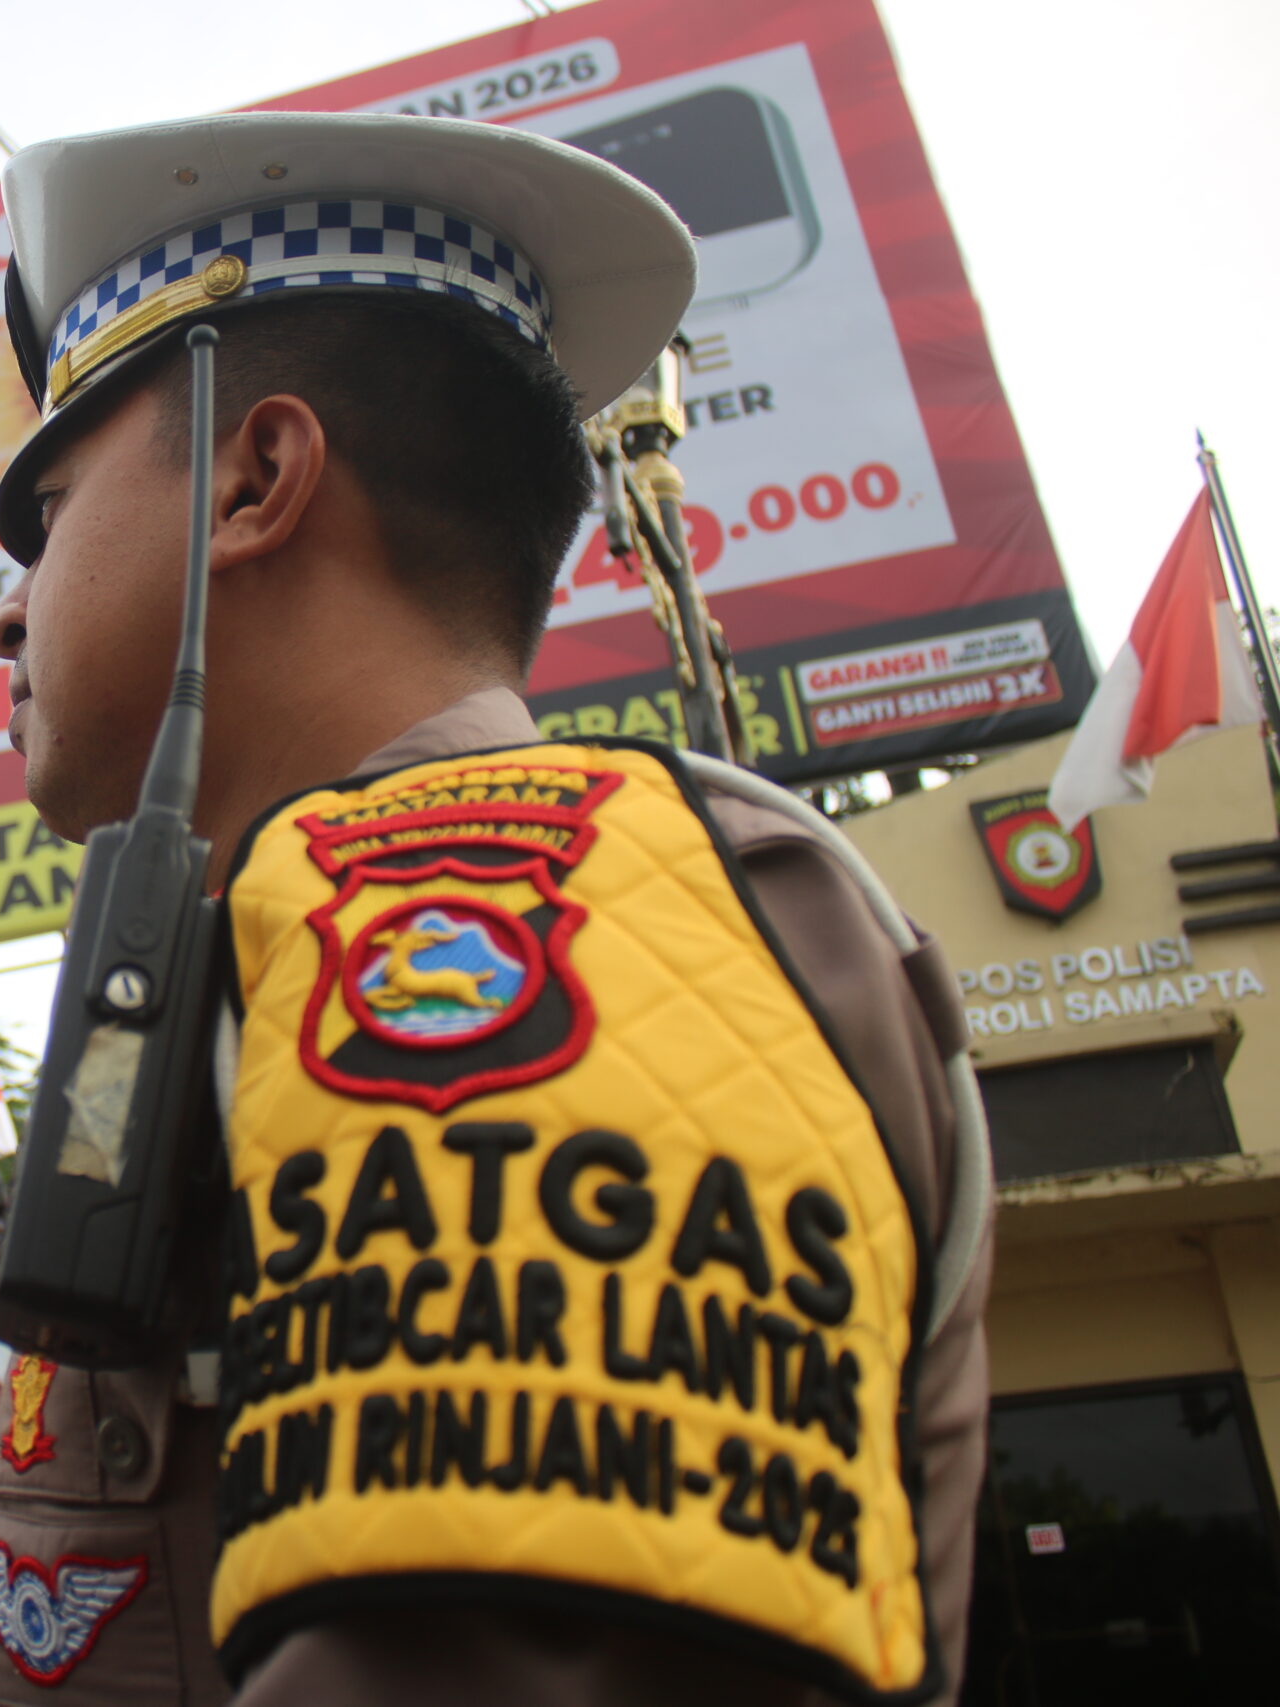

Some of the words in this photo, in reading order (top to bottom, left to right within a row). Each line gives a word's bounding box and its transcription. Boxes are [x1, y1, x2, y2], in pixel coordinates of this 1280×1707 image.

[475, 52, 599, 111] 2026
[683, 383, 775, 428] TER
[808, 652, 926, 691] GARANSI
[816, 697, 896, 732] GANTI
[344, 785, 561, 825] MATARAM
[956, 959, 1044, 997] POS
[1051, 935, 1193, 987] POLISI
[964, 997, 1055, 1036] ROLI
[1064, 966, 1265, 1023] SAMAPTA
